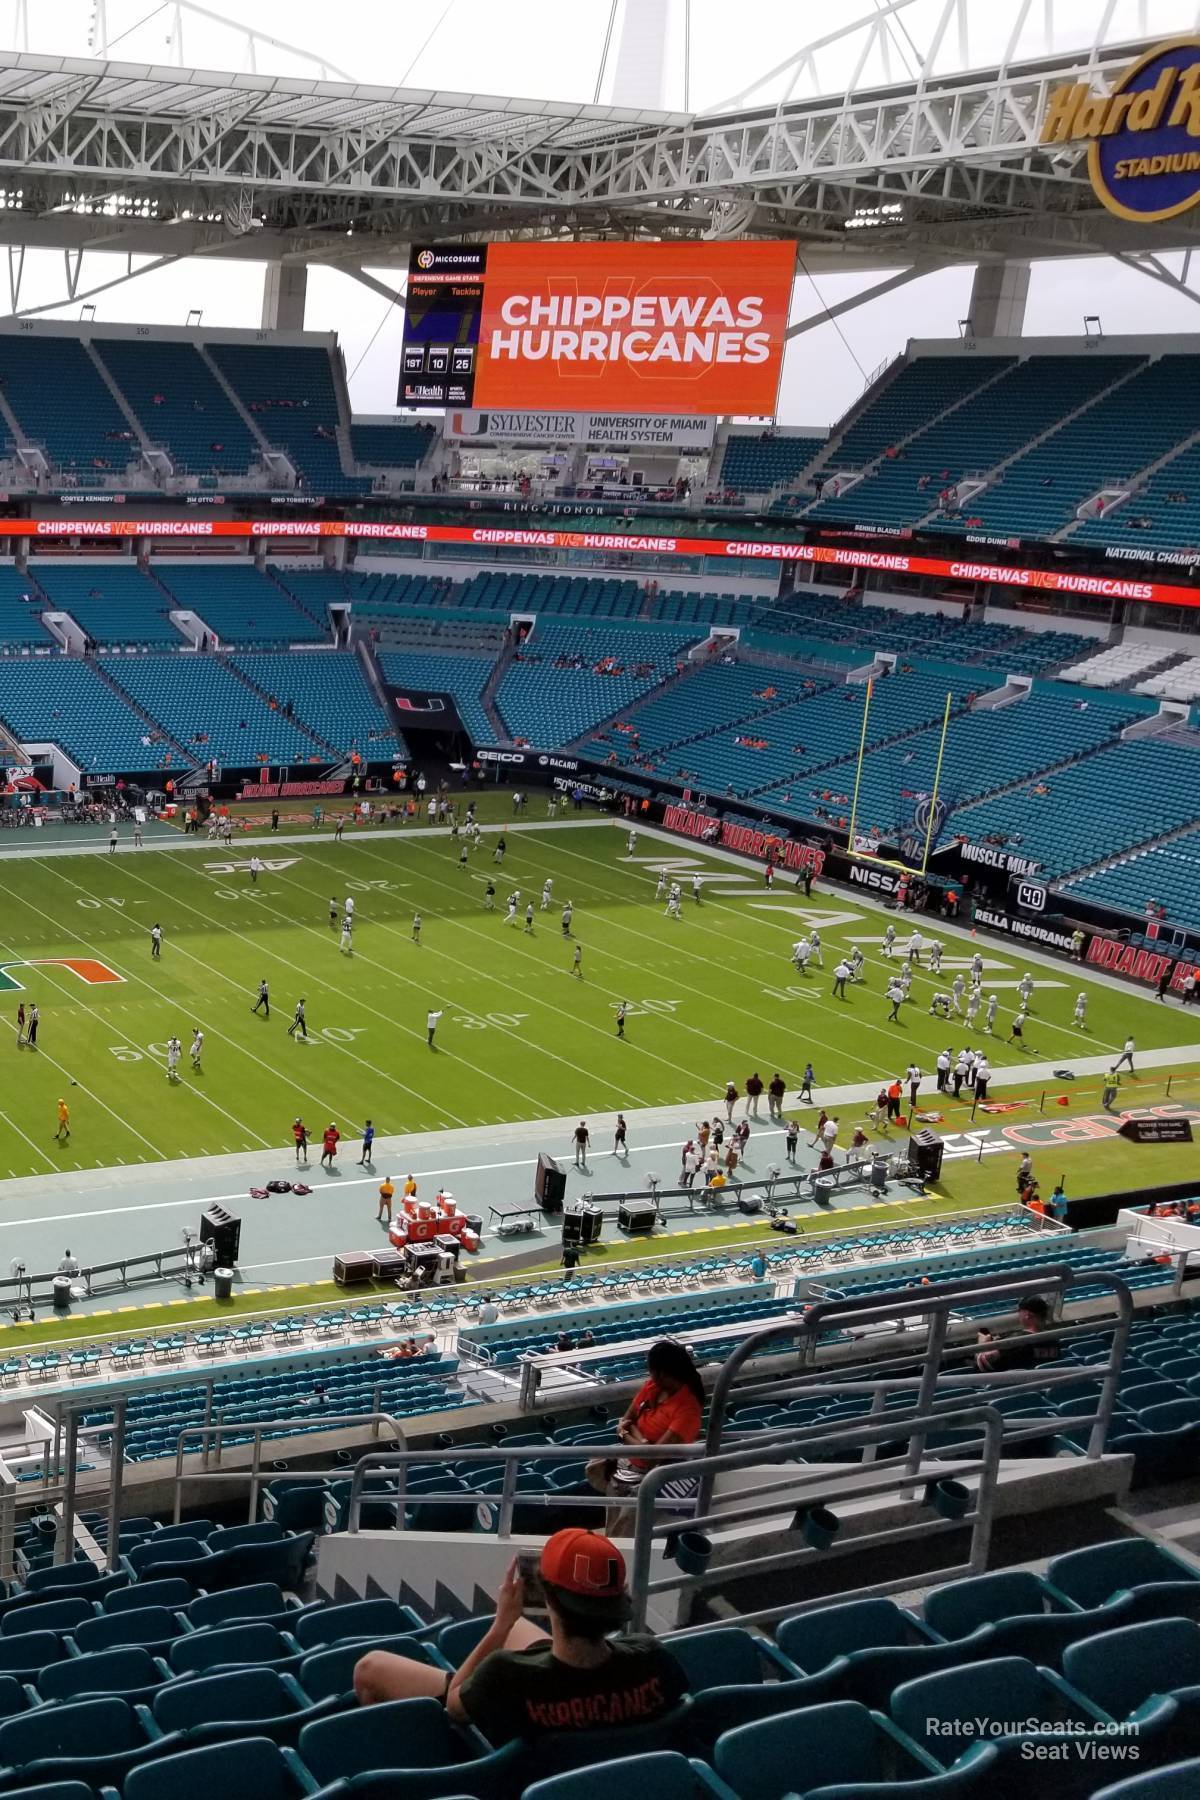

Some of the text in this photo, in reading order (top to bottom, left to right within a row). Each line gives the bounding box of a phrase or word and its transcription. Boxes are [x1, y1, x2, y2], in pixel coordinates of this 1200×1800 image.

[1039, 66, 1178, 143] Hard
[434, 255, 481, 264] MICCOSUKEE
[412, 287, 481, 297] Player Tackles
[501, 295, 763, 328] CHIPPEWAS
[490, 330, 770, 363] HURRICANES
[406, 359, 422, 368] 1ST
[432, 359, 443, 369] 10
[490, 413, 576, 433] SYLVESTER
[589, 416, 708, 431] UNIVERSITY OF MIAMI
[588, 429, 674, 442] HEALTH SYSTEM
[504, 502, 604, 515] RING HONOR
[37, 521, 112, 534] CHIPPEWAS
[136, 522, 213, 535] HURRICANES
[252, 522, 321, 534] CHIPPEWAS
[345, 523, 428, 538] HURRICANES
[473, 529, 555, 545] CHIPPEWAS
[584, 534, 676, 551] HURRICANES
[966, 535, 987, 544] EDDIE
[987, 537, 1007, 546] DUNN
[726, 542, 813, 559] CHIPPEWAS
[835, 551, 909, 570] HURRICANES
[1105, 547, 1156, 561] NATIONAL
[950, 564, 1029, 585] CHIPPEWAS
[1057, 576, 1153, 599] HURRICANES
[476, 750, 524, 763] GEICO
[243, 780, 346, 798] MIAMI HURRICANES
[961, 843, 1040, 877] MUSCLE MILK
[851, 864, 903, 893] NISSA
[1022, 886, 1041, 907] 40
[616, 856, 1071, 990] MIAMI
[974, 907, 1076, 951] RELLA INSURANC
[1087, 935, 1173, 984] MIAMI
[761, 984, 820, 1002] 10
[608, 997, 678, 1017] 20
[451, 1010, 522, 1031] 30
[293, 1025, 357, 1045] 40
[108, 1040, 171, 1064] 50
[417, 1224, 427, 1236] G
[450, 1220, 460, 1232] G
[573, 1553, 618, 1588] U
